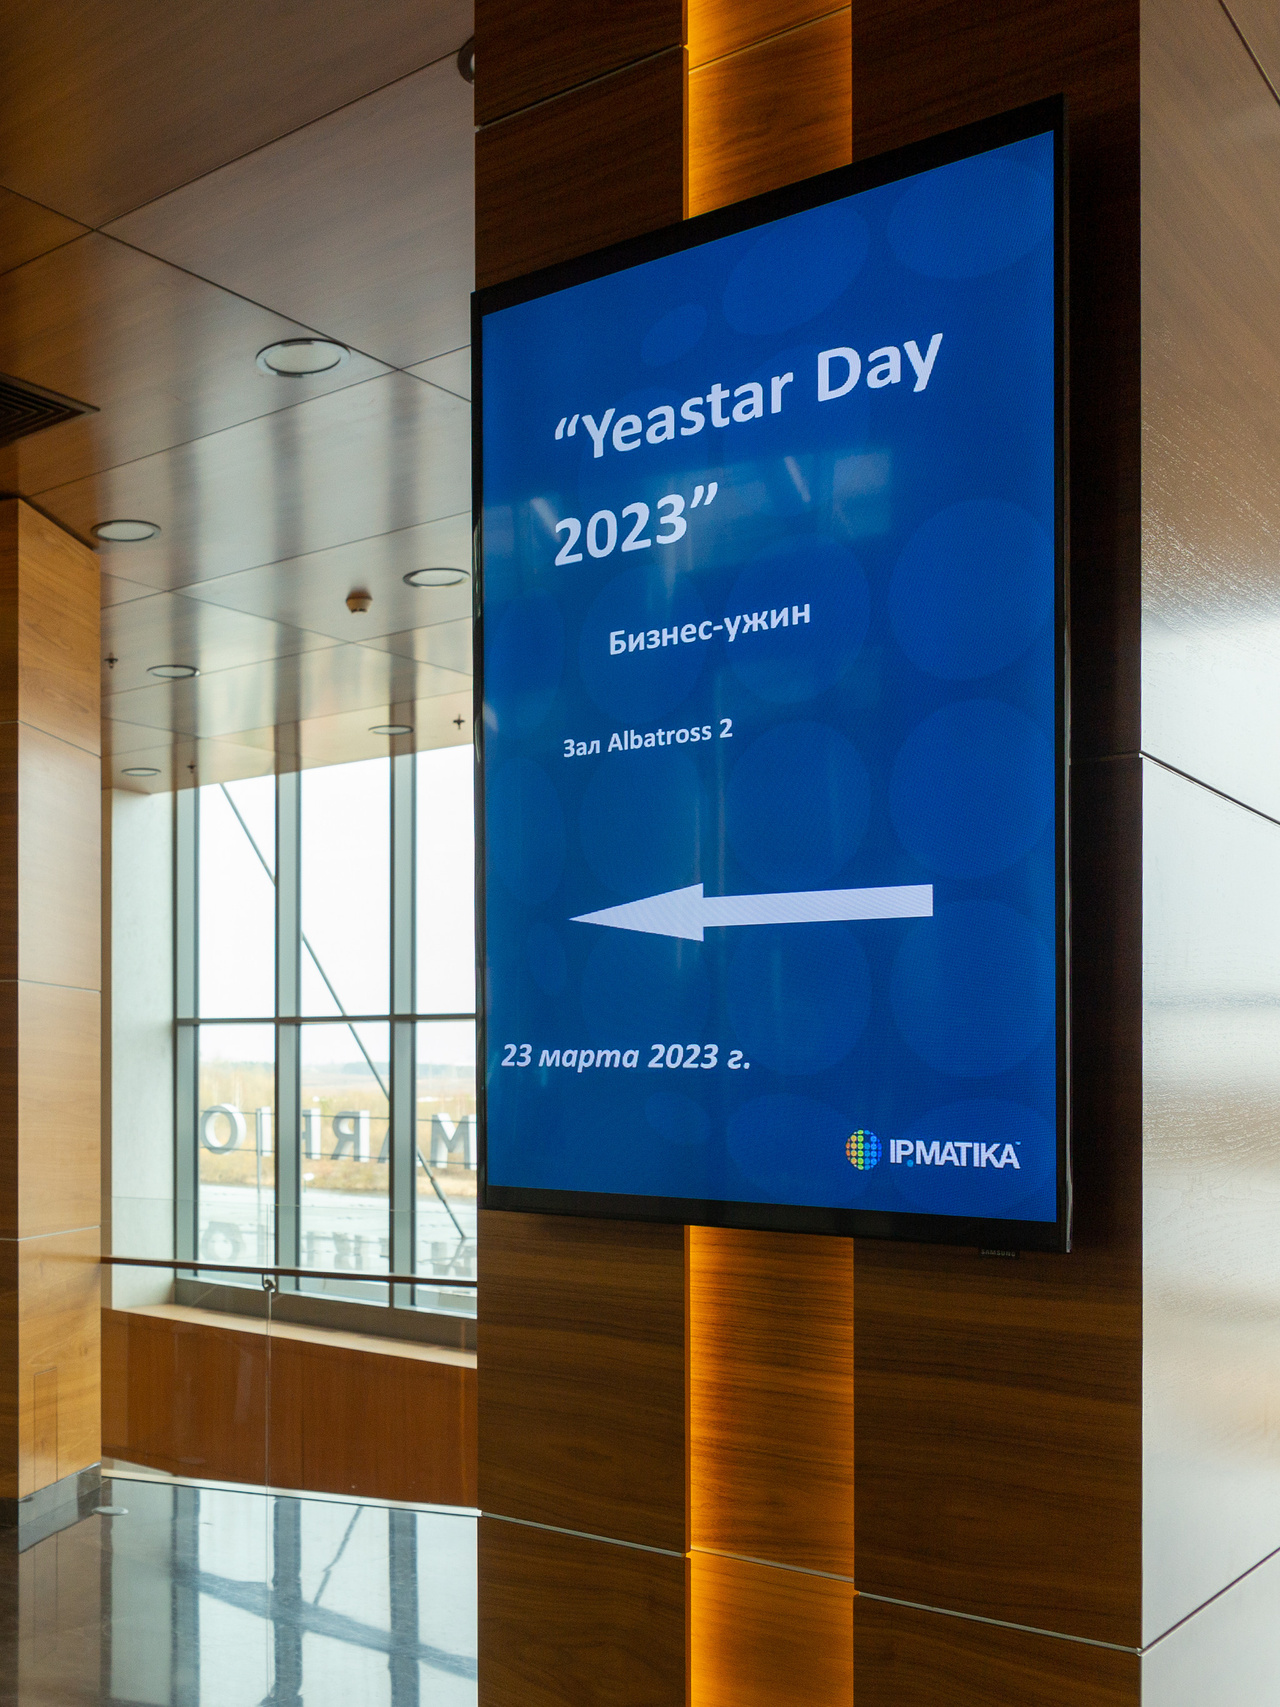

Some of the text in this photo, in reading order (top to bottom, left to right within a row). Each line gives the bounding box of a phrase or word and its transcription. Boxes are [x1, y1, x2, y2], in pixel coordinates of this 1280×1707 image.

[554, 332, 943, 458] “Yeastar Day
[554, 481, 718, 566] 2023”
[610, 603, 810, 656] Бизнес-ужин
[563, 718, 733, 758] Зал Albatross 2
[501, 1043, 750, 1073] 23 марта 2023 г.
[980, 1249, 1016, 1257] SAMSUNG
